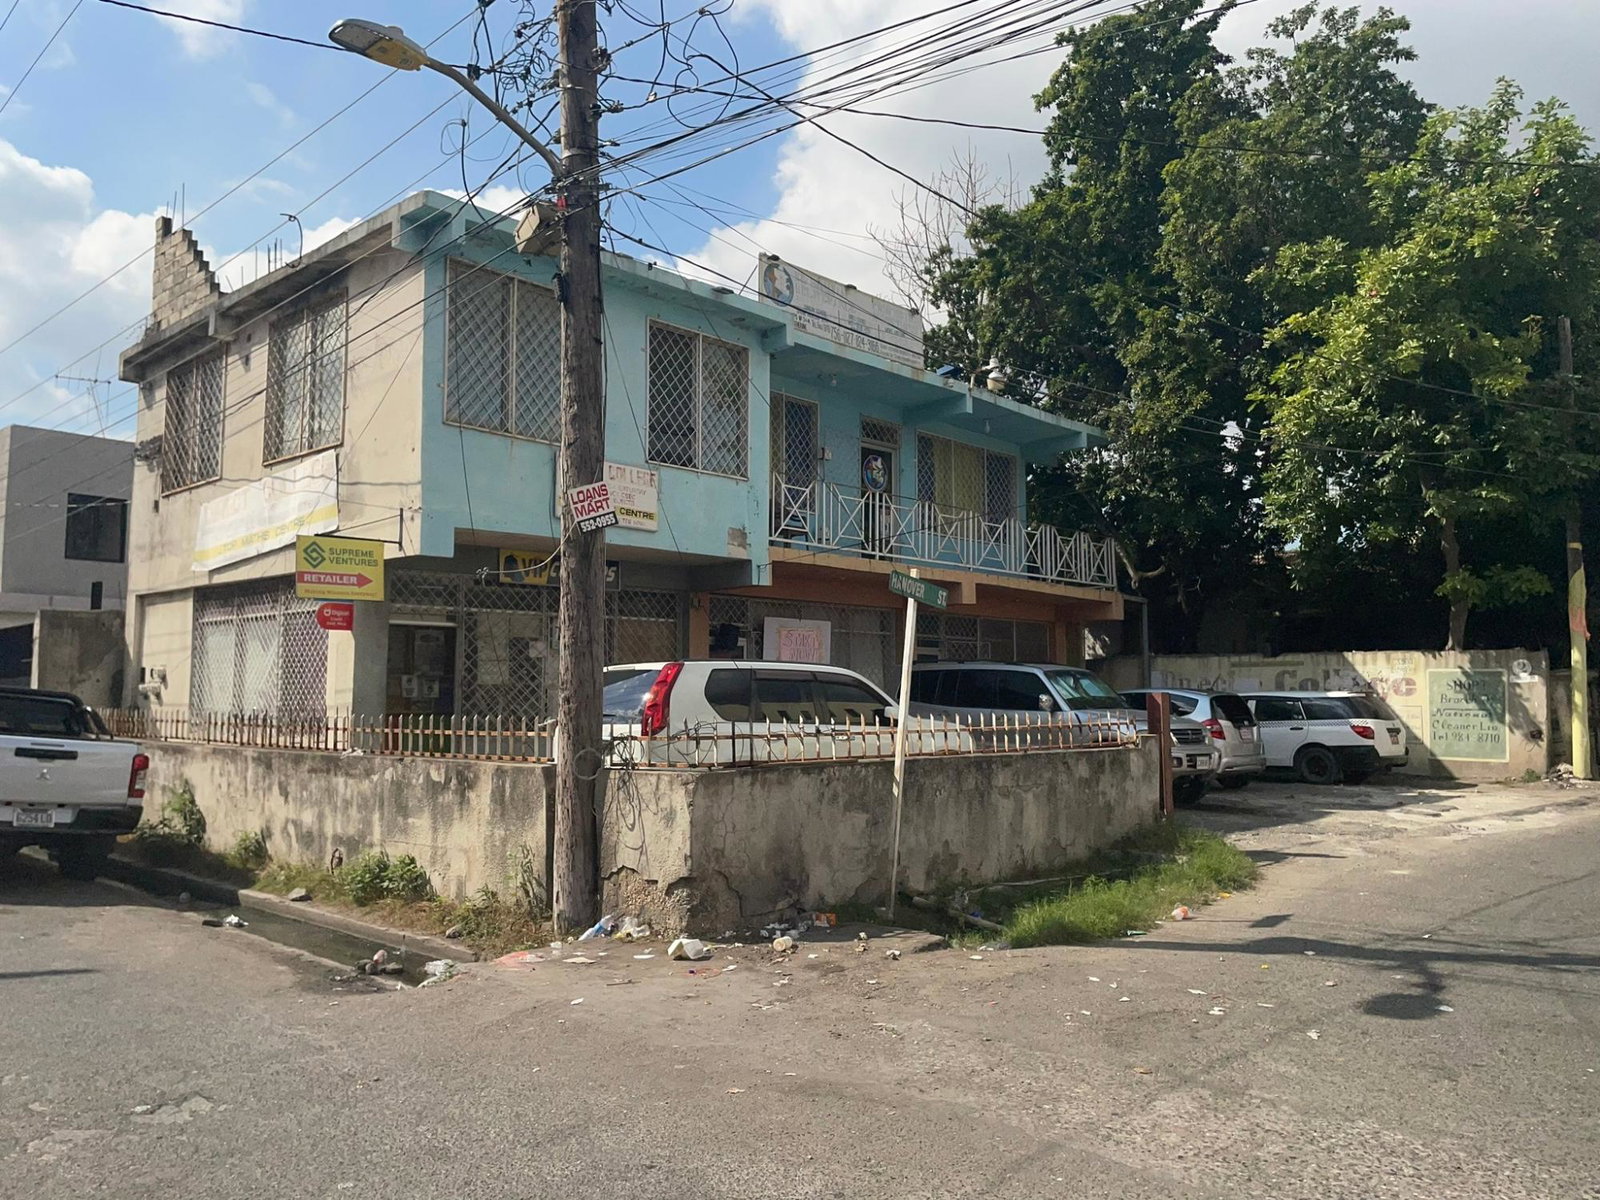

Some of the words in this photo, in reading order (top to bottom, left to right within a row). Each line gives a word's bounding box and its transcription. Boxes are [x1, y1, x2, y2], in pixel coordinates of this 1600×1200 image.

[570, 484, 609, 506] LOANS
[573, 497, 610, 518] MART
[619, 507, 655, 520] CENTRE
[580, 513, 616, 533] 552-0955
[328, 547, 374, 558] SUPREME
[328, 556, 379, 567] VENTURES
[521, 557, 549, 579] VIP
[303, 573, 357, 585] RETAILER
[891, 573, 925, 598] HANOVER
